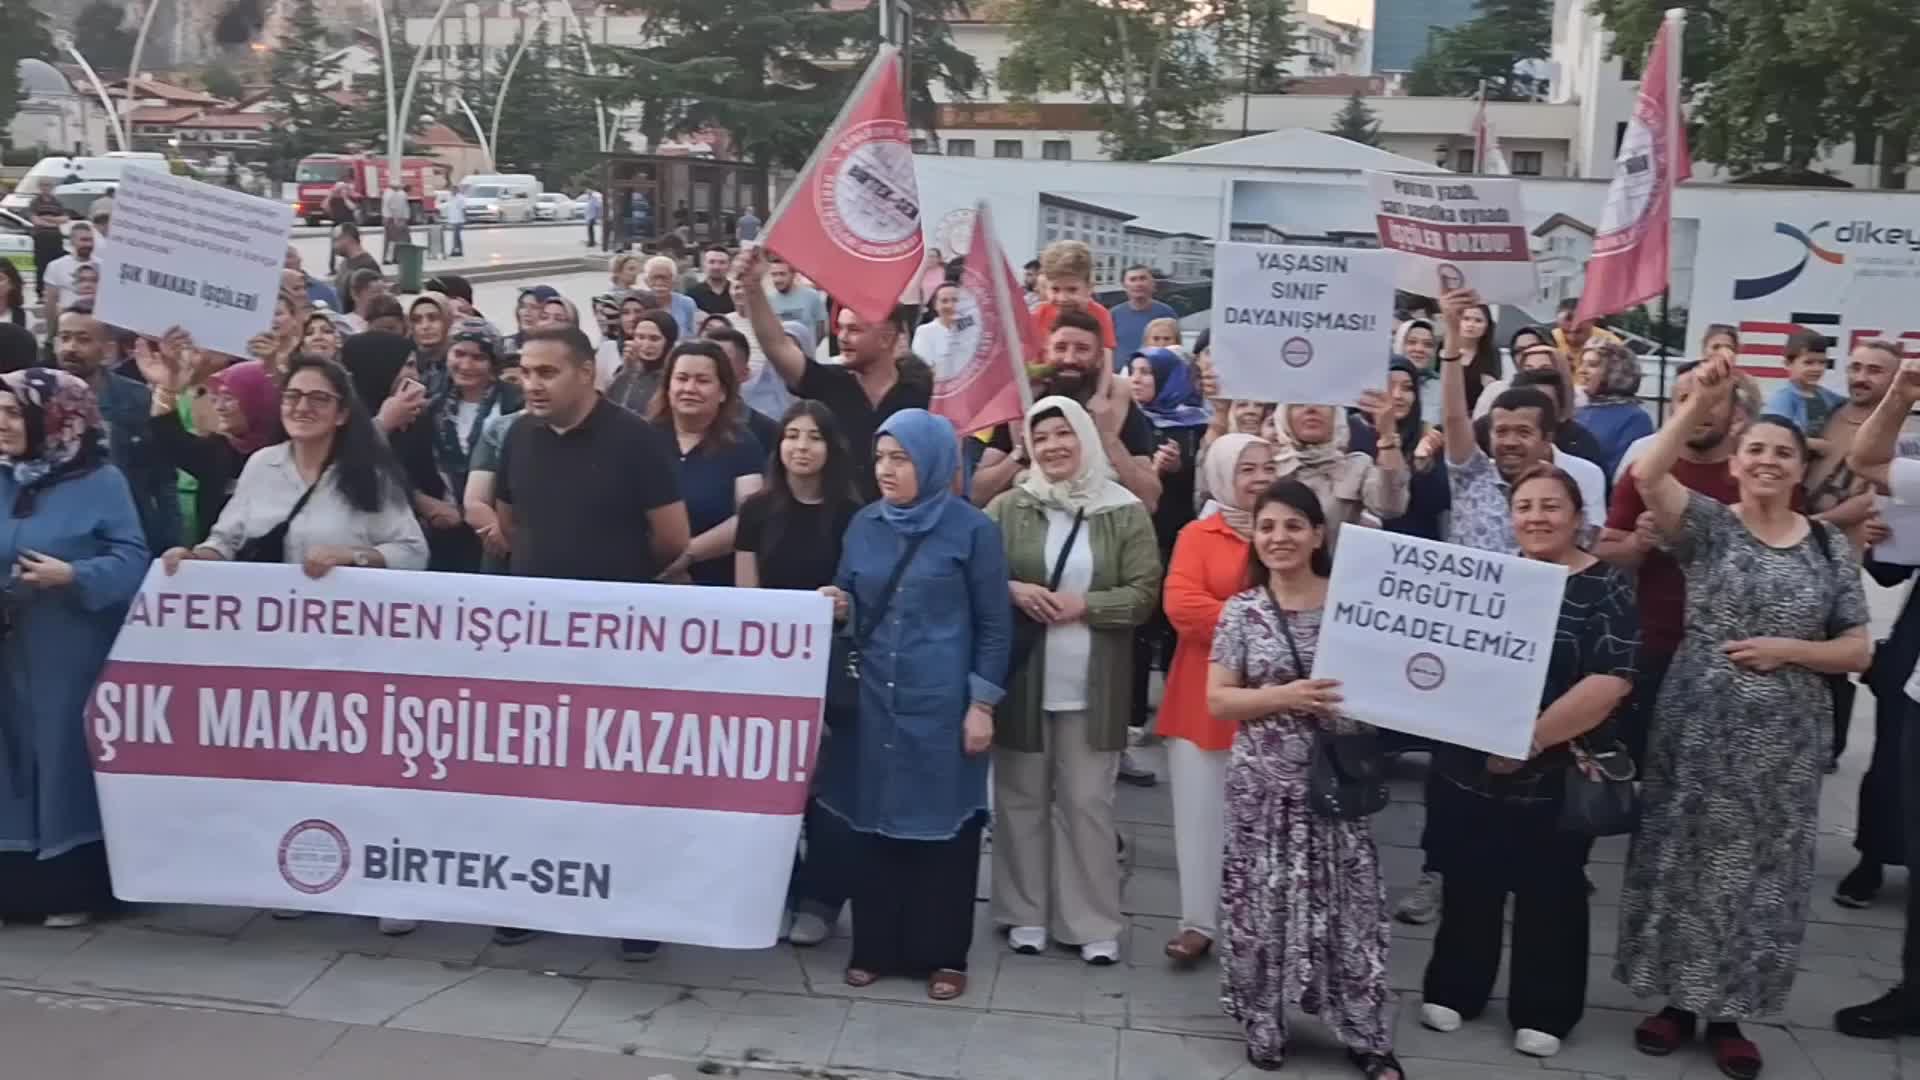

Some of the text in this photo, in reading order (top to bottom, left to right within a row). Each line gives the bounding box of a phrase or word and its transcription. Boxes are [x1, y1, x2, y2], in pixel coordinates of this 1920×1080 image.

[119, 263, 142, 284] ŞIK
[147, 269, 198, 296] MAKAS
[1256, 252, 1348, 275] YAŞASIN
[1271, 281, 1328, 300] SINIF
[1224, 307, 1376, 332] DAYANIŞMASI!
[1392, 543, 1504, 584] YAŞASIN
[1379, 570, 1506, 619] ÖRGÜTLÜ
[256, 589, 442, 640] DİRENEN
[456, 597, 666, 652] İŞÇİLERİN
[680, 618, 812, 659] OLDU!
[1333, 601, 1537, 662] MÜCADELEMİZ!
[94, 681, 810, 782] ŞIK MAKAS İŞÇİLERİ KAZANDI!
[363, 837, 611, 899] BİRTEK-SEN
